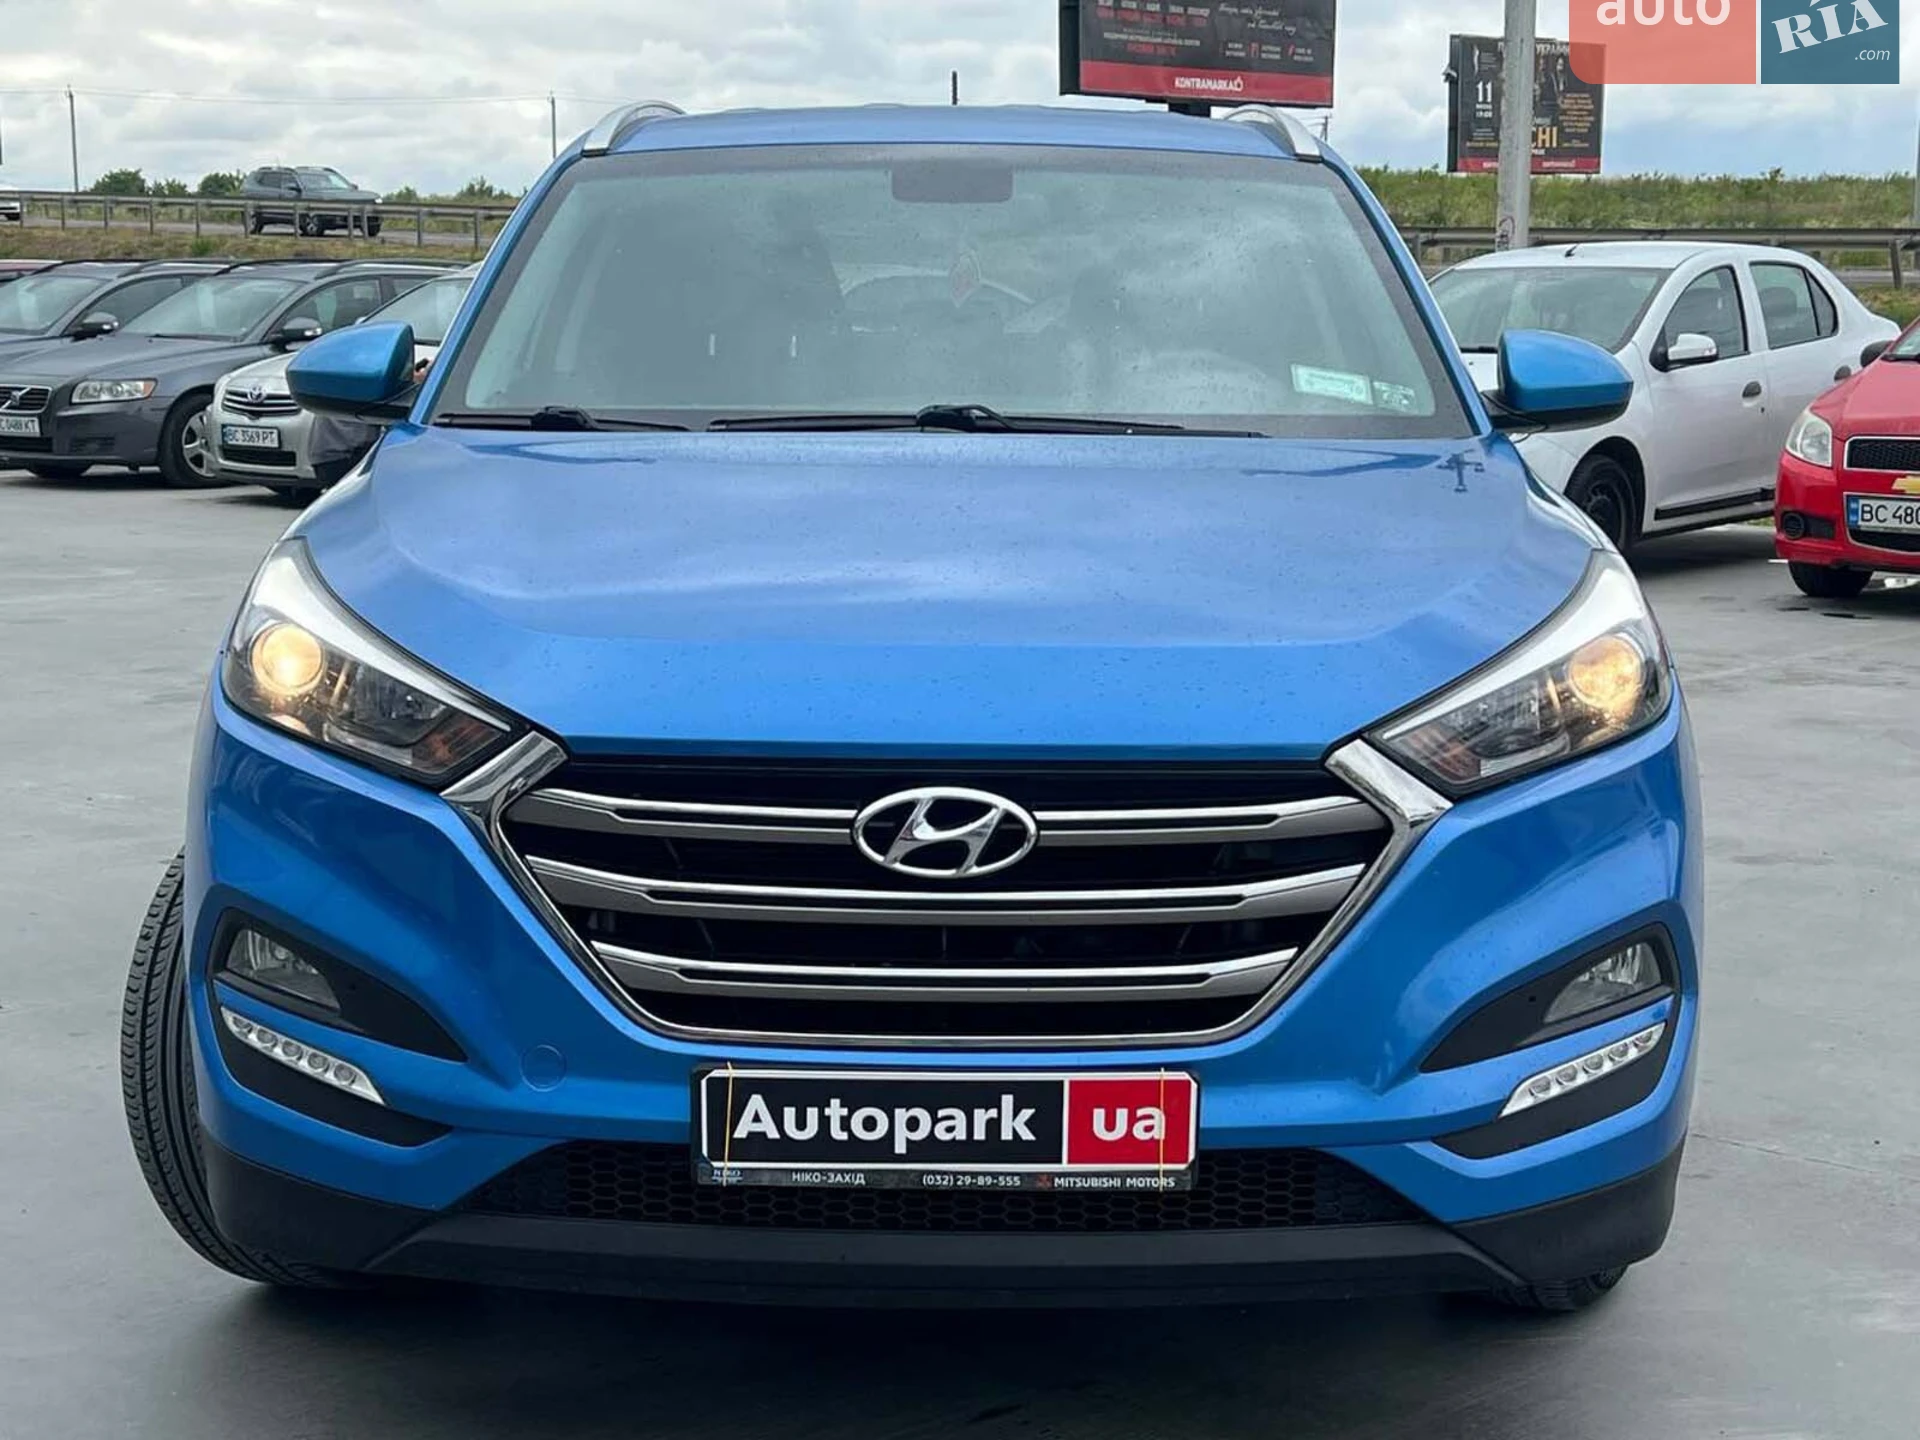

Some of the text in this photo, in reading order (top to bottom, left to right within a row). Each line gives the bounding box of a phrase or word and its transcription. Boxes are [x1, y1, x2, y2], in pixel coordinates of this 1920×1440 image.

[1475, 80, 1492, 103] 11
[1860, 503, 1888, 523] BC
[732, 1094, 1036, 1154] Autopark
[1092, 1106, 1166, 1141] ua
[922, 1174, 1021, 1187] (032) 29-89-555
[1054, 1176, 1175, 1188] MITSUBISHI MOTORS
